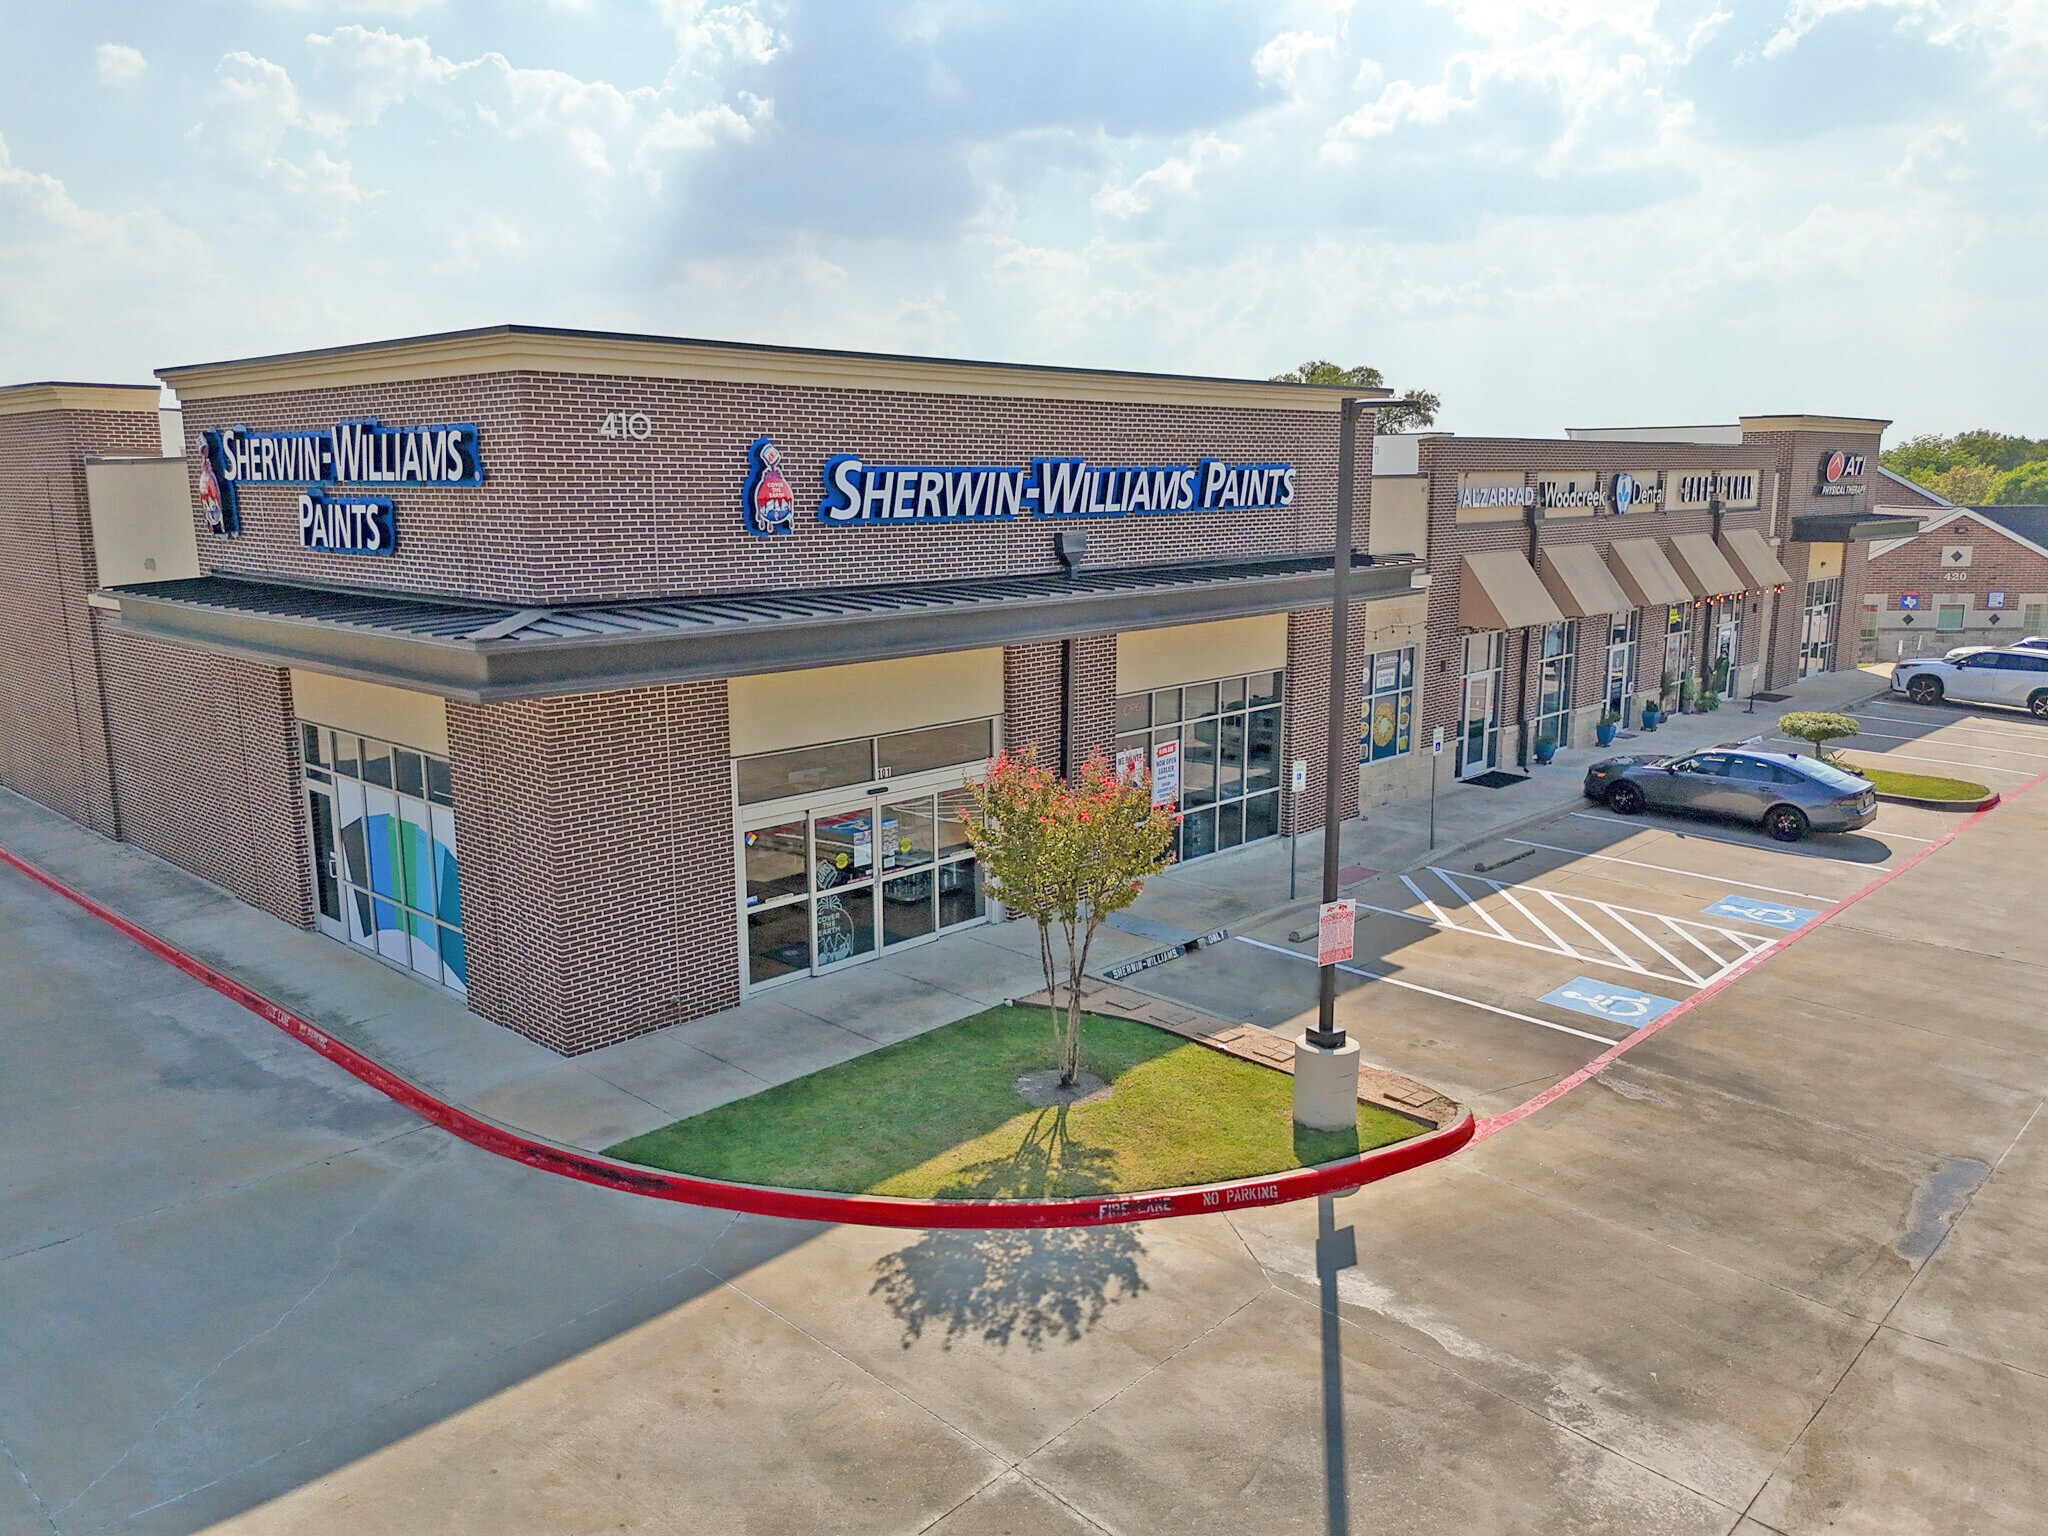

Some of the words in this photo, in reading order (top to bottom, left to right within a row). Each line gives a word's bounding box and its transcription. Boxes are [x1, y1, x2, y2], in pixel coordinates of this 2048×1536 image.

[601, 412, 651, 440] 410
[222, 424, 463, 482] SHERWIN-WILLIAMS
[1844, 456, 1866, 476] ATI
[829, 459, 1197, 521] SHERWIN-WILLIAMS
[1203, 462, 1296, 508] PAINTS
[1459, 486, 1534, 508] ALZARRAD
[1544, 481, 1606, 507] Woodcreek
[1633, 480, 1665, 505] Dental
[1821, 485, 1845, 495] PHYSICAL
[300, 494, 381, 551] PAINTS
[1944, 572, 1967, 581] 420
[818, 912, 840, 923] COVER
[823, 920, 836, 929] THE
[818, 926, 841, 937] EARTH
[1208, 930, 1226, 945] ONLY
[1202, 1191, 1219, 1206] NO
[1226, 1184, 1278, 1204] PARKING
